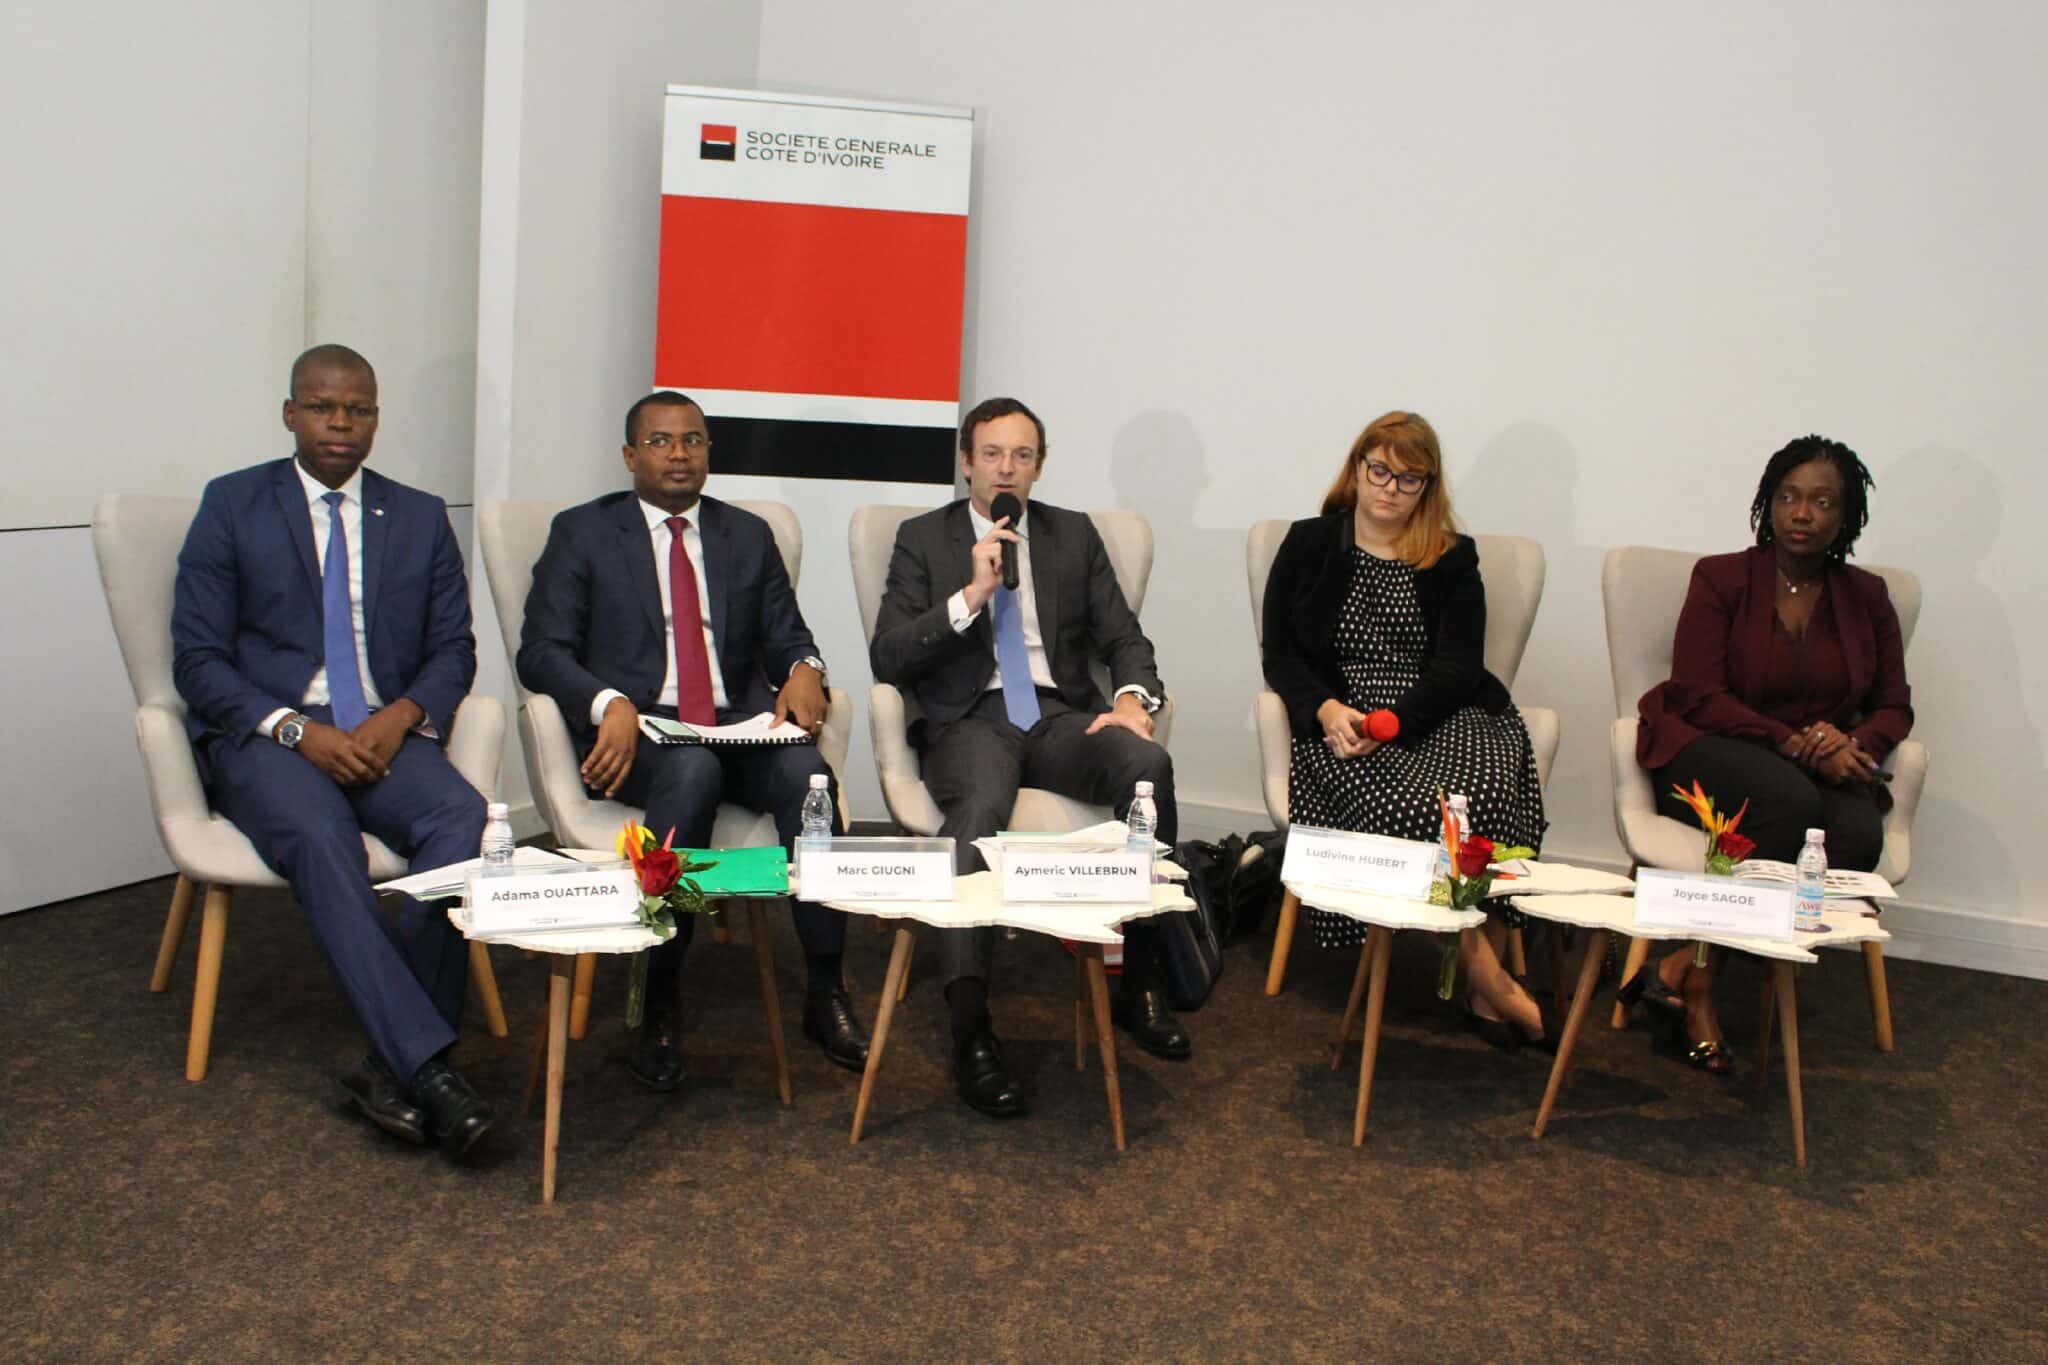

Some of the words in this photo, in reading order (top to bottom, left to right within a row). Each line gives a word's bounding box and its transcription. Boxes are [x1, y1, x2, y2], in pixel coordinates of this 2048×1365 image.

[746, 130, 829, 149] SOCIETE
[834, 137, 937, 158] GENERALE
[745, 147, 798, 163] COTE
[803, 151, 885, 169] D'IVOIRE
[1305, 847, 1356, 862] Ludivine
[1359, 855, 1408, 869] HUBERT
[837, 865, 869, 875] Marc
[871, 865, 916, 876] GIUGNI
[1015, 865, 1066, 877] Aymeric
[1068, 866, 1137, 876] VILLEBRUN
[491, 890, 540, 901] Adama
[543, 884, 619, 898] OUATTARA
[1672, 888, 1709, 902] Joyce
[1711, 892, 1757, 906] SAGOE
